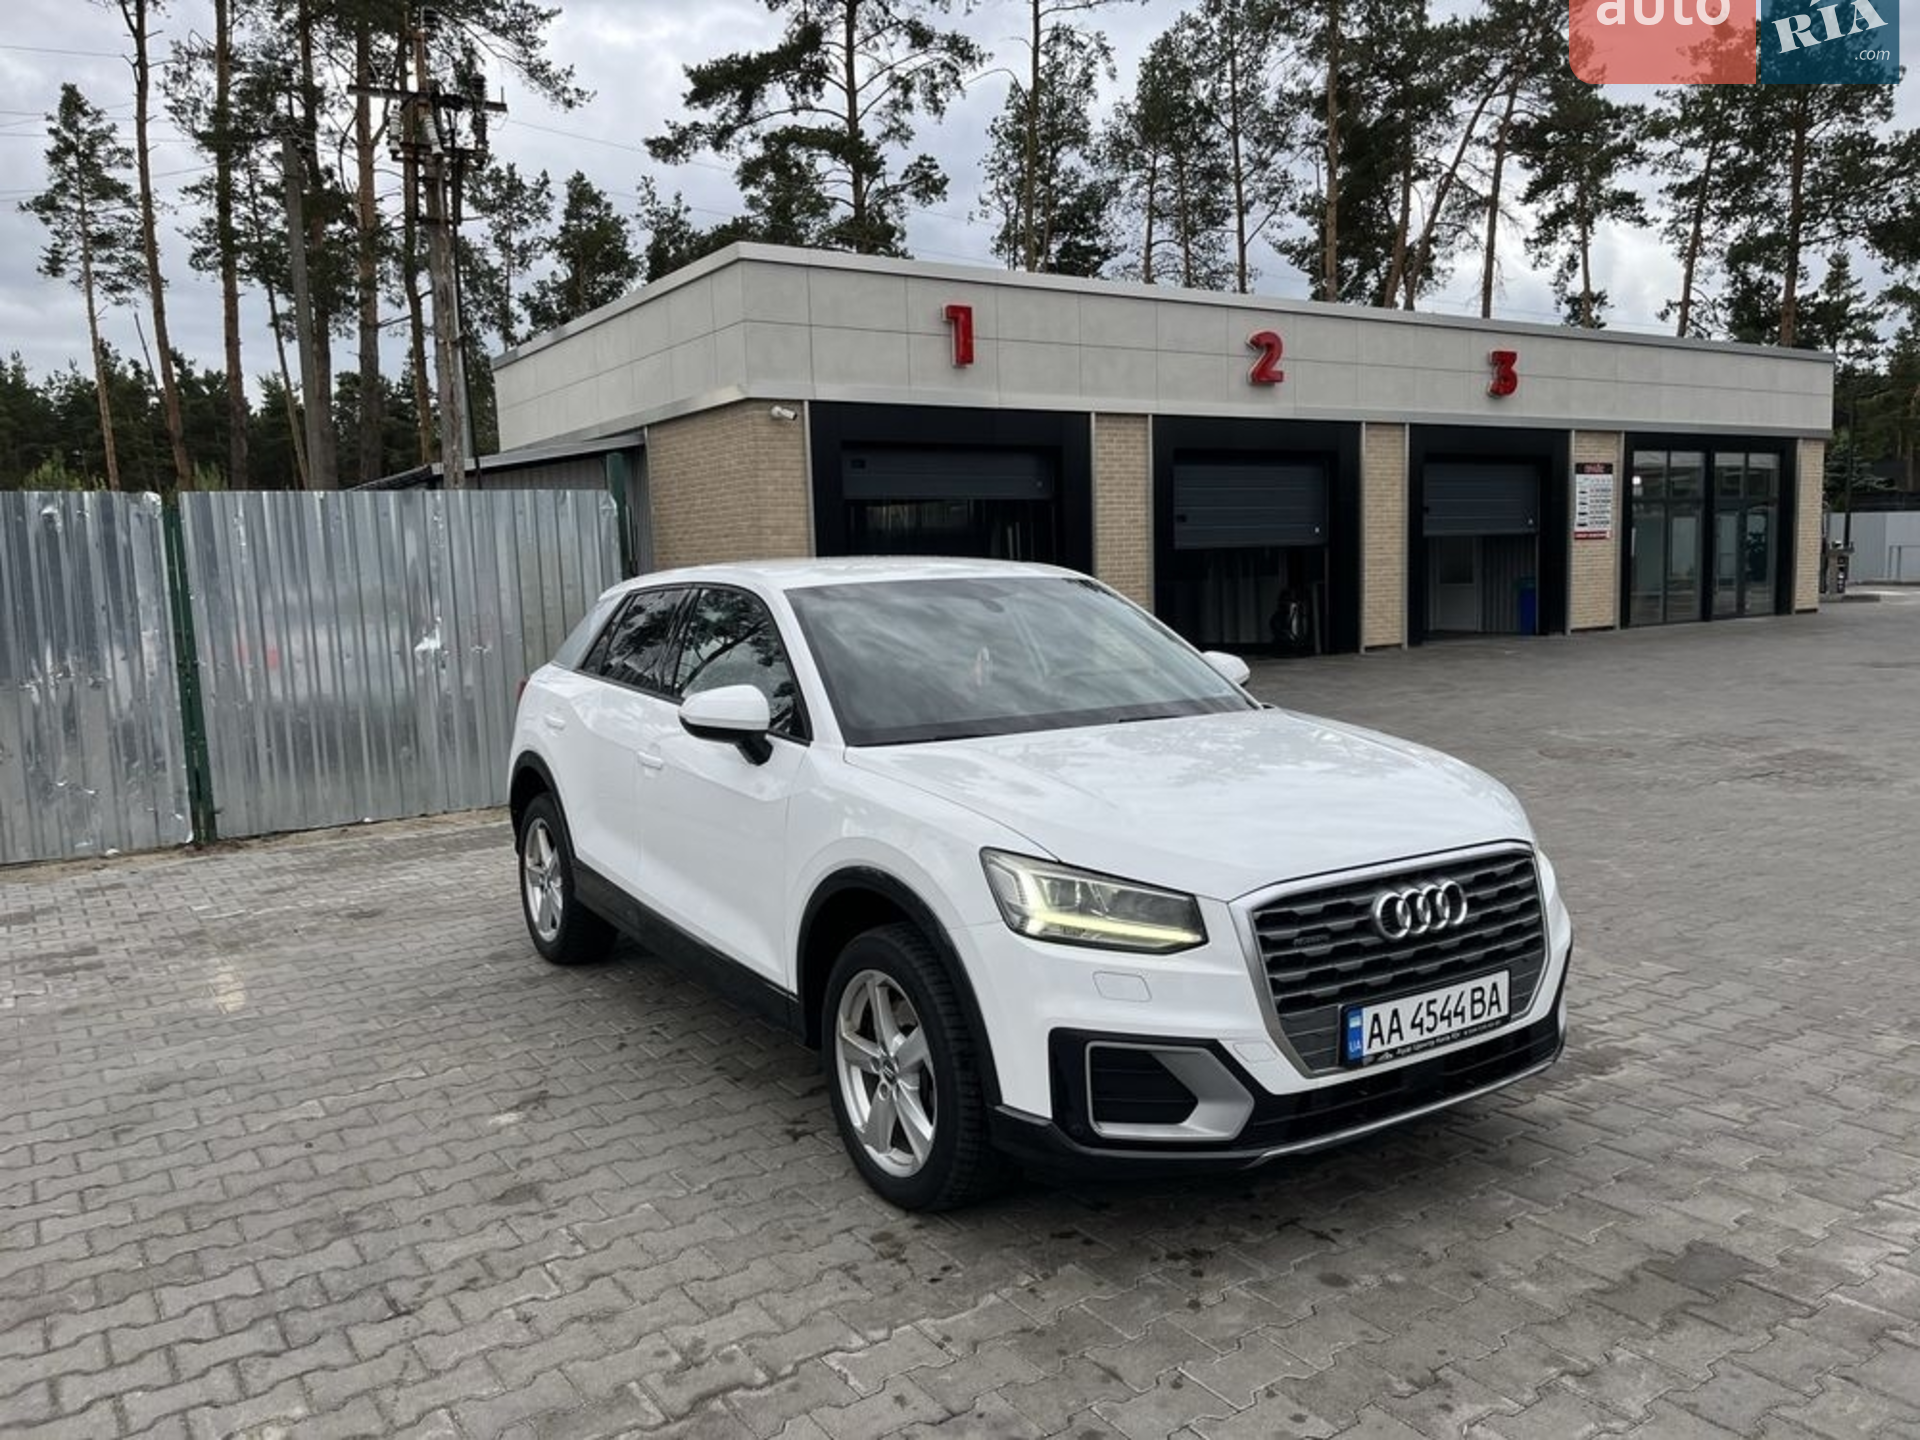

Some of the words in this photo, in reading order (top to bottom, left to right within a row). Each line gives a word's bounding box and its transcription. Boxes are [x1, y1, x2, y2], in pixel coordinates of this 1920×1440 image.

[942, 304, 974, 367] 1
[1245, 331, 1284, 386] 2
[1488, 350, 1518, 397] 3
